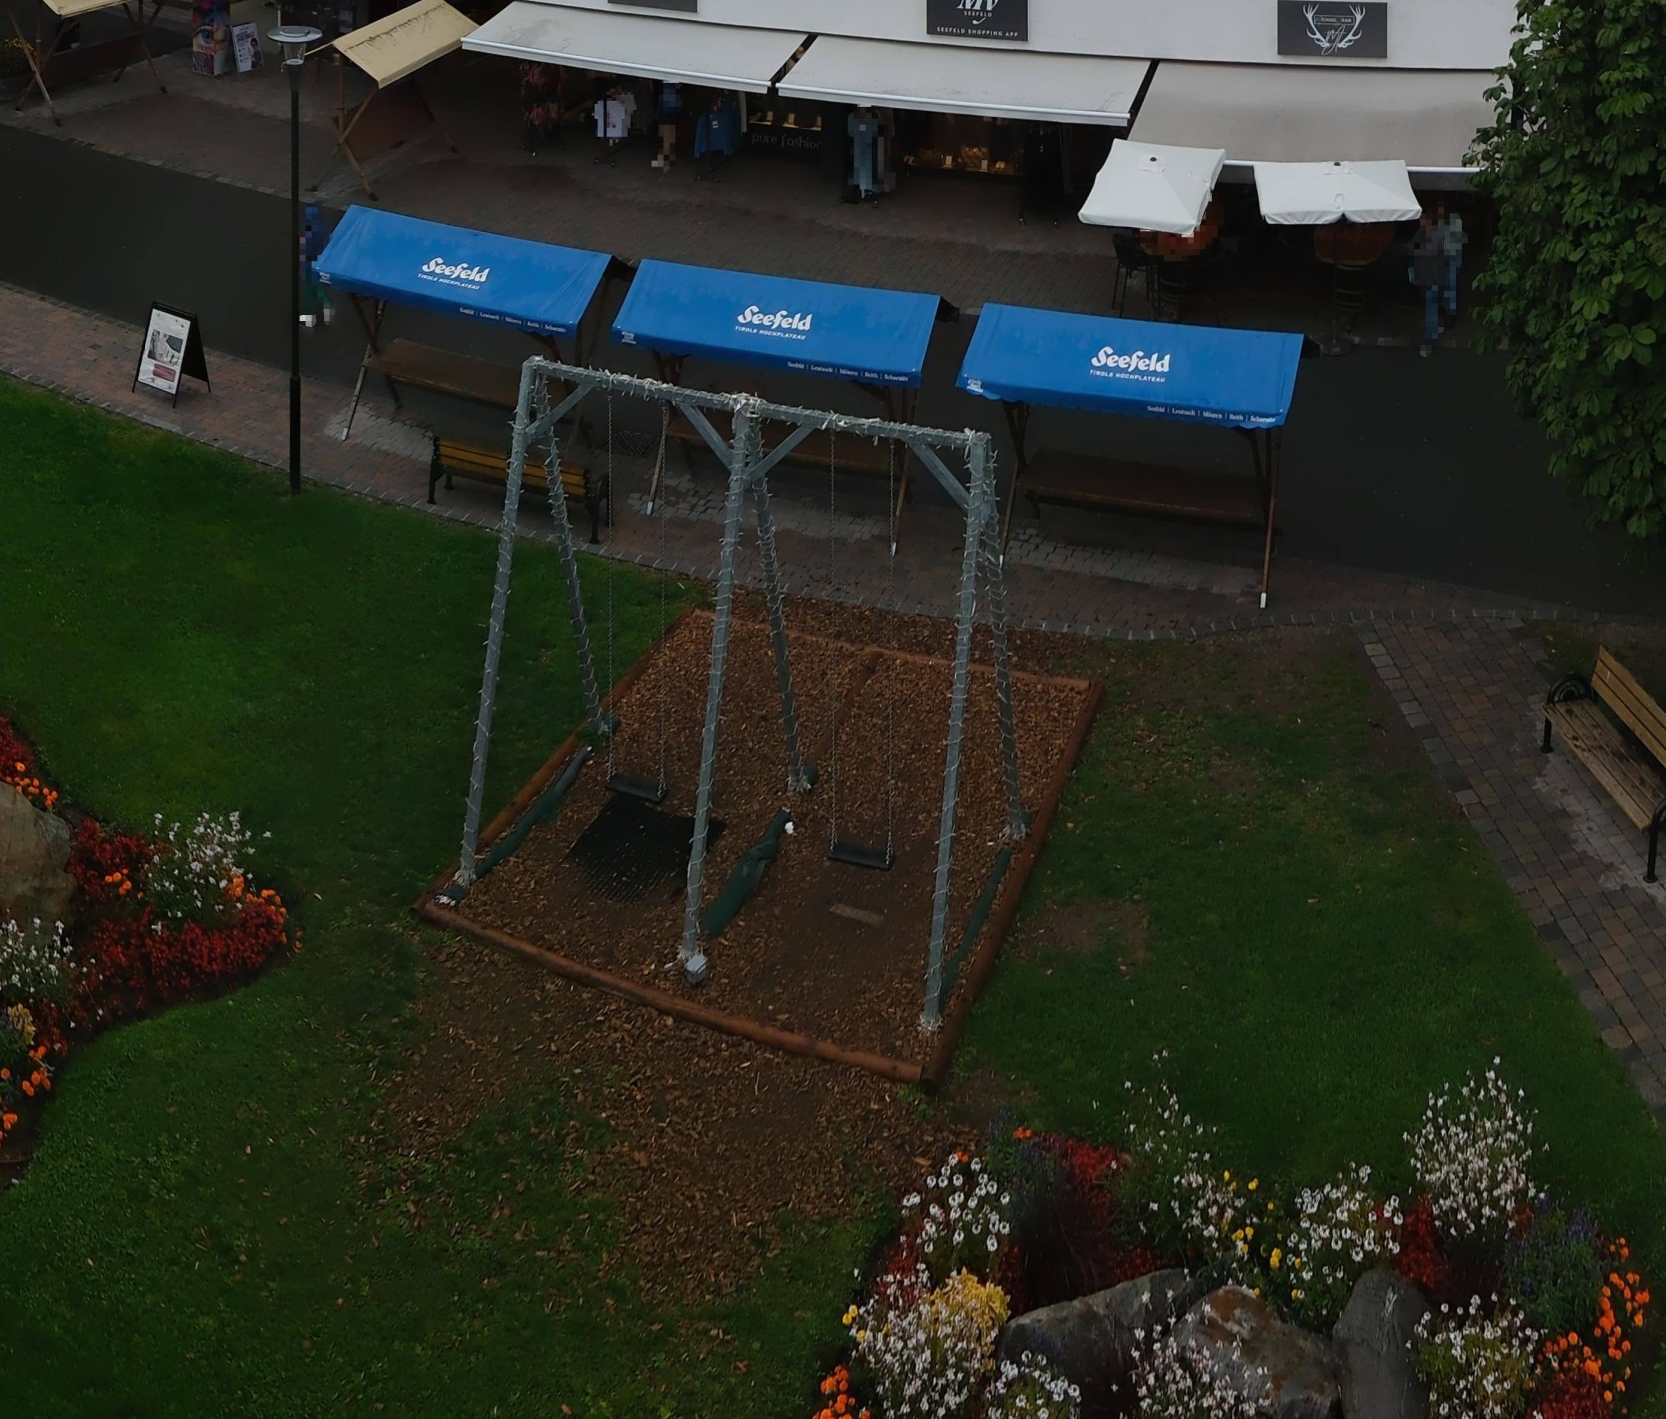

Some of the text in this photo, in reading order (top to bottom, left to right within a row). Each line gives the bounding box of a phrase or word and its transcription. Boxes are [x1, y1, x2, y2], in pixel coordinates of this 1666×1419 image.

[937, 26, 966, 34] SEEFELD
[968, 28, 1003, 36] SHOPPING
[422, 257, 491, 283] Seefeld
[737, 305, 813, 332] Seefeld
[735, 325, 807, 341] TIROLS HOCHPLATEAU
[1091, 346, 1171, 373] Seefeld
[1090, 369, 1166, 383] TIROLS HOCHPLATEAU
